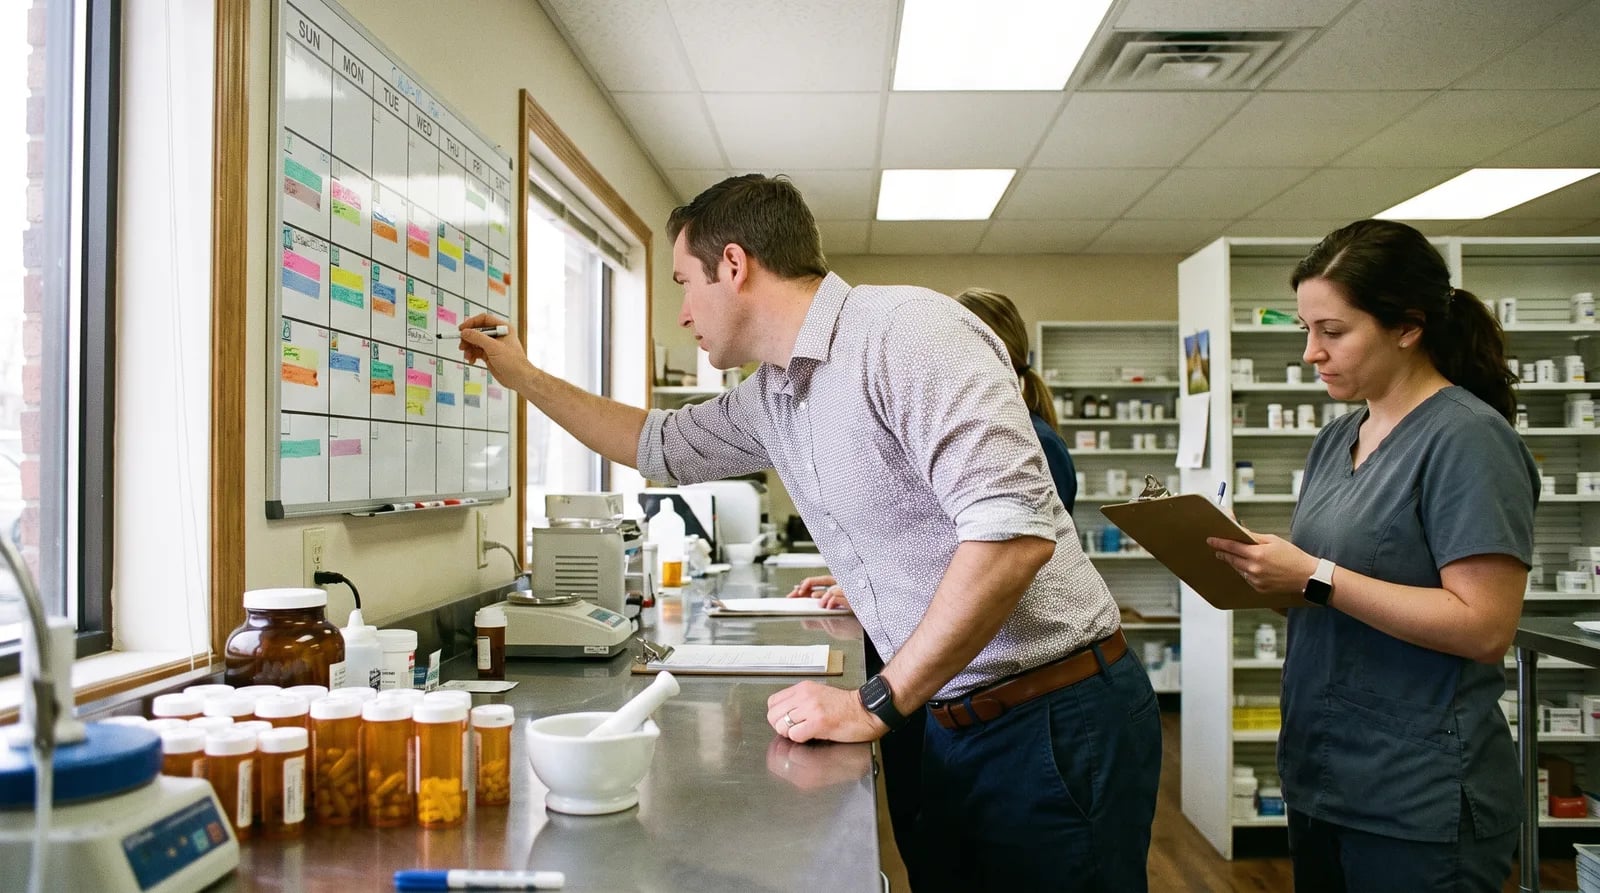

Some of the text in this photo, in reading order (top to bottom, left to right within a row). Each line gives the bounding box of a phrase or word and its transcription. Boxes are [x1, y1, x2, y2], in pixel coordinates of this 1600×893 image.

[299, 20, 320, 50] SUN
[343, 55, 364, 84] MON
[384, 87, 399, 112] TUE
[416, 113, 432, 137] WED
[446, 137, 459, 158] THU
[473, 159, 482, 177] FRI
